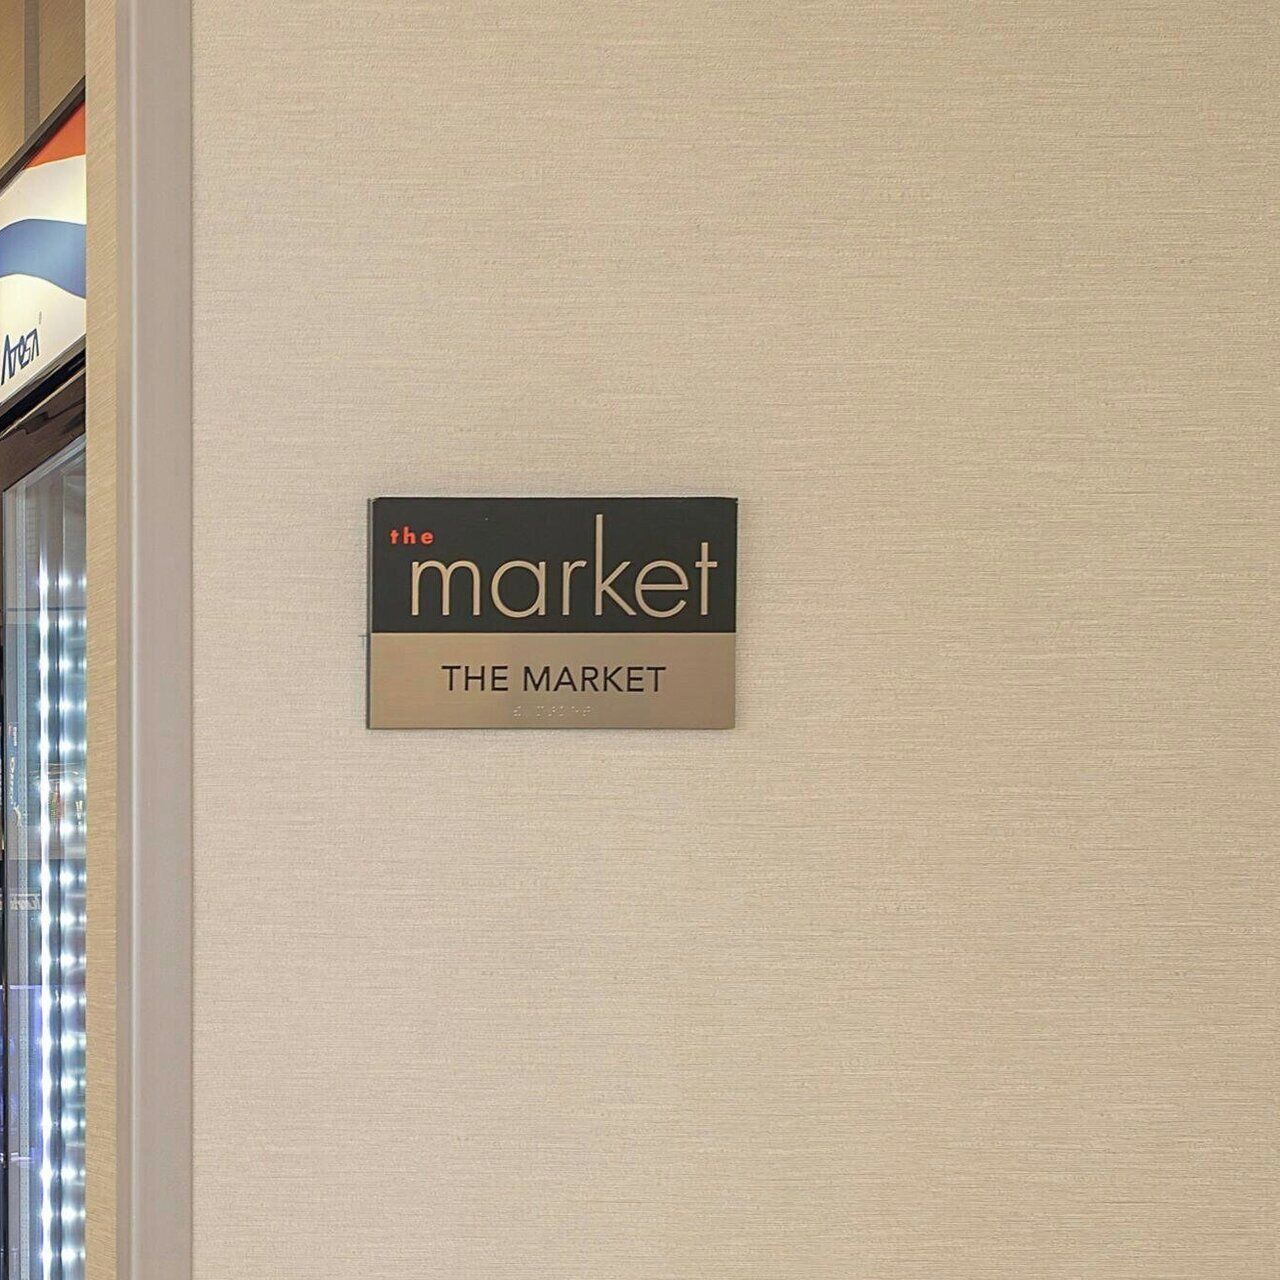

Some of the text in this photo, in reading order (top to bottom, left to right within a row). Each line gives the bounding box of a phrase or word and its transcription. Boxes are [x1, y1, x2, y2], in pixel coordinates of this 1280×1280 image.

[389, 526, 434, 545] the
[410, 513, 718, 618] market
[441, 666, 666, 692] THE MARKET
